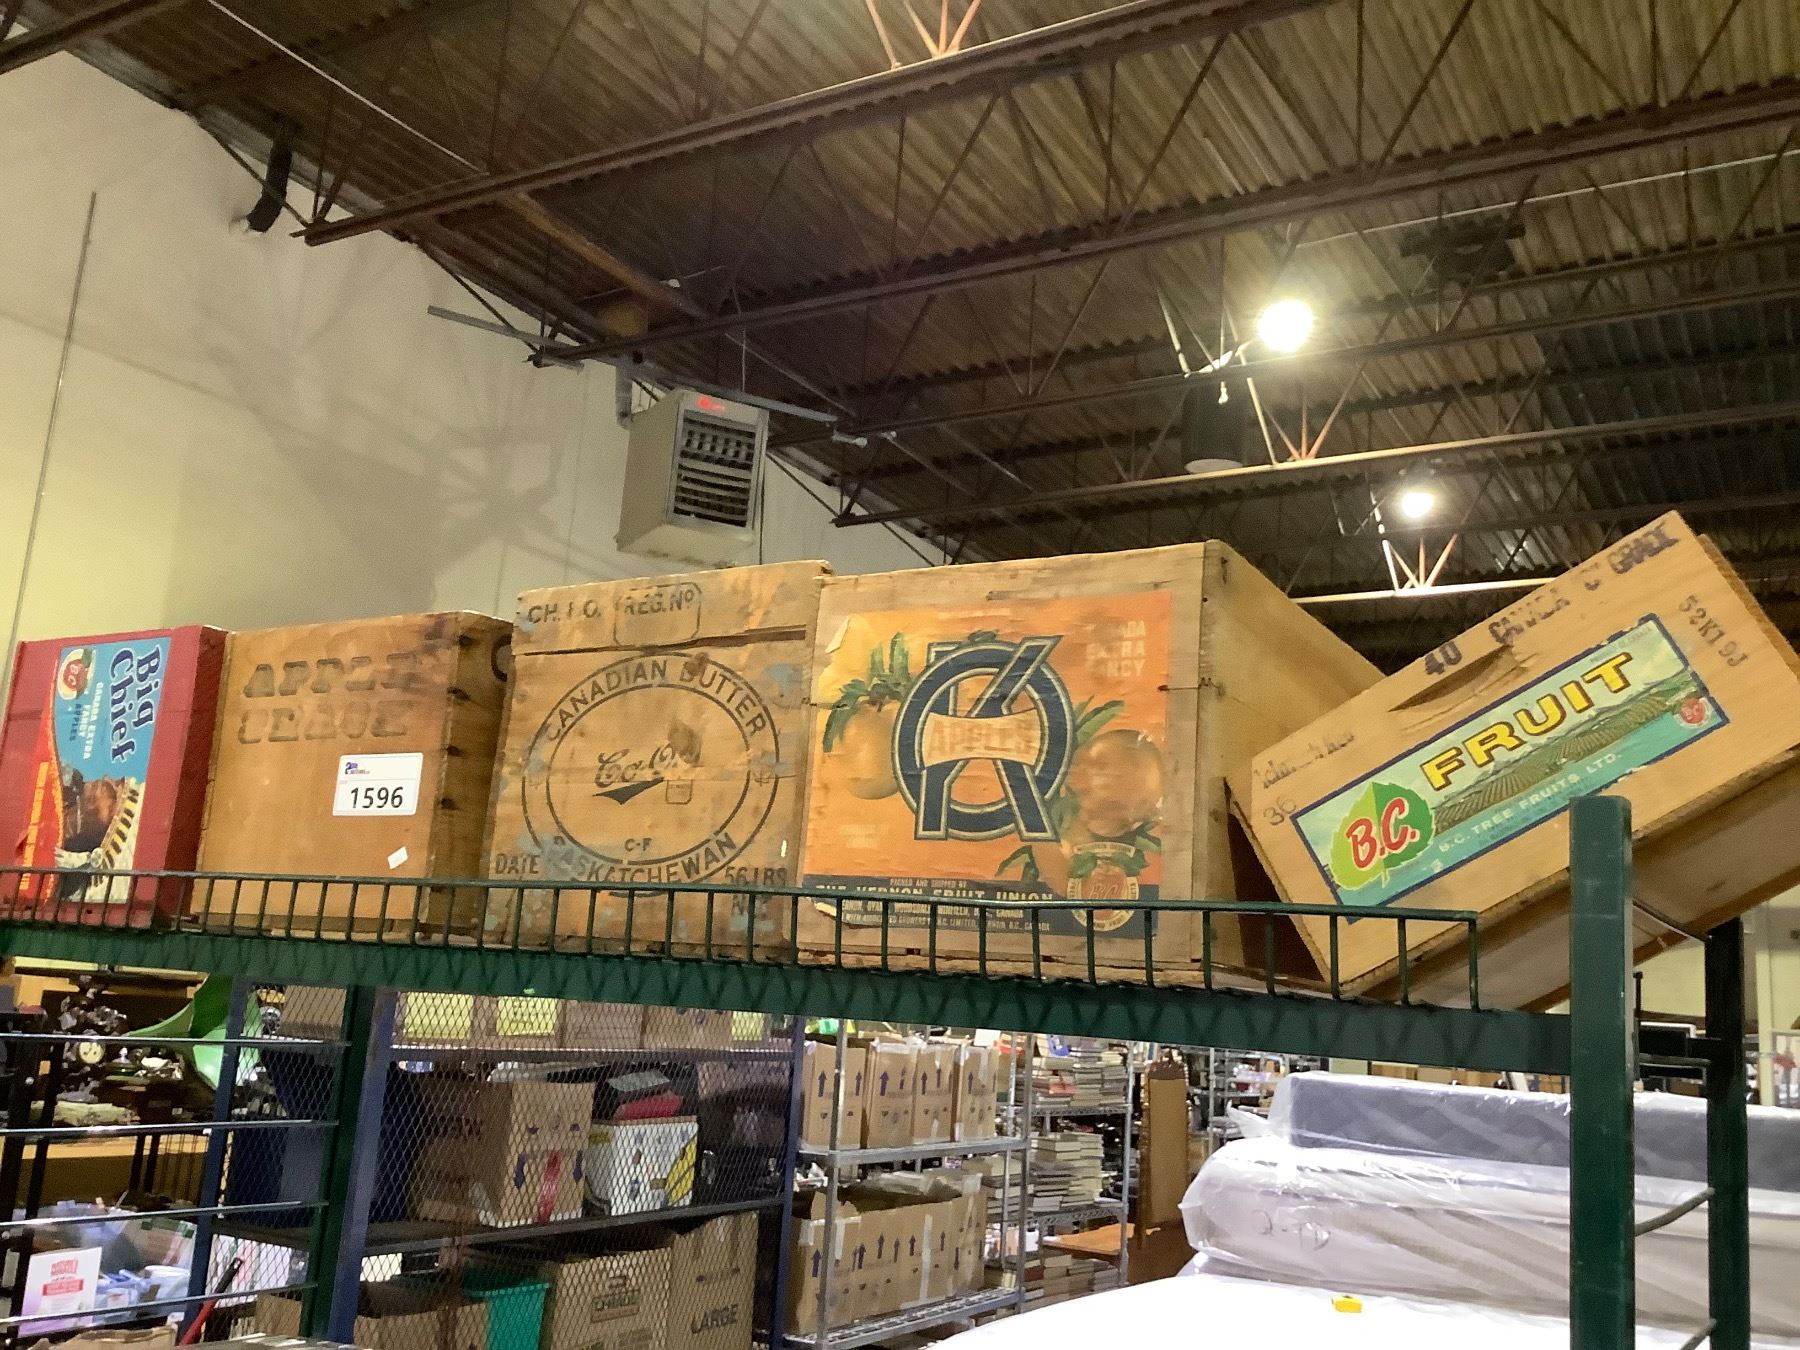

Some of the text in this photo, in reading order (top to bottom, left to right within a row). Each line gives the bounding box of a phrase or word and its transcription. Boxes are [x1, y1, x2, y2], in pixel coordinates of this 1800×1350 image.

[133, 645, 161, 729] Big
[1424, 641, 1462, 675] 40
[110, 648, 136, 763] Chief
[546, 659, 767, 742] CANADIAN BUTTER
[1420, 652, 1634, 792] FRUIT
[350, 786, 404, 809] 1596
[1345, 797, 1418, 869] B.C.
[1471, 809, 1514, 835] TREE
[1518, 773, 1581, 810] FRUITS
[1585, 753, 1622, 774] LTD.
[495, 853, 541, 876] DATE
